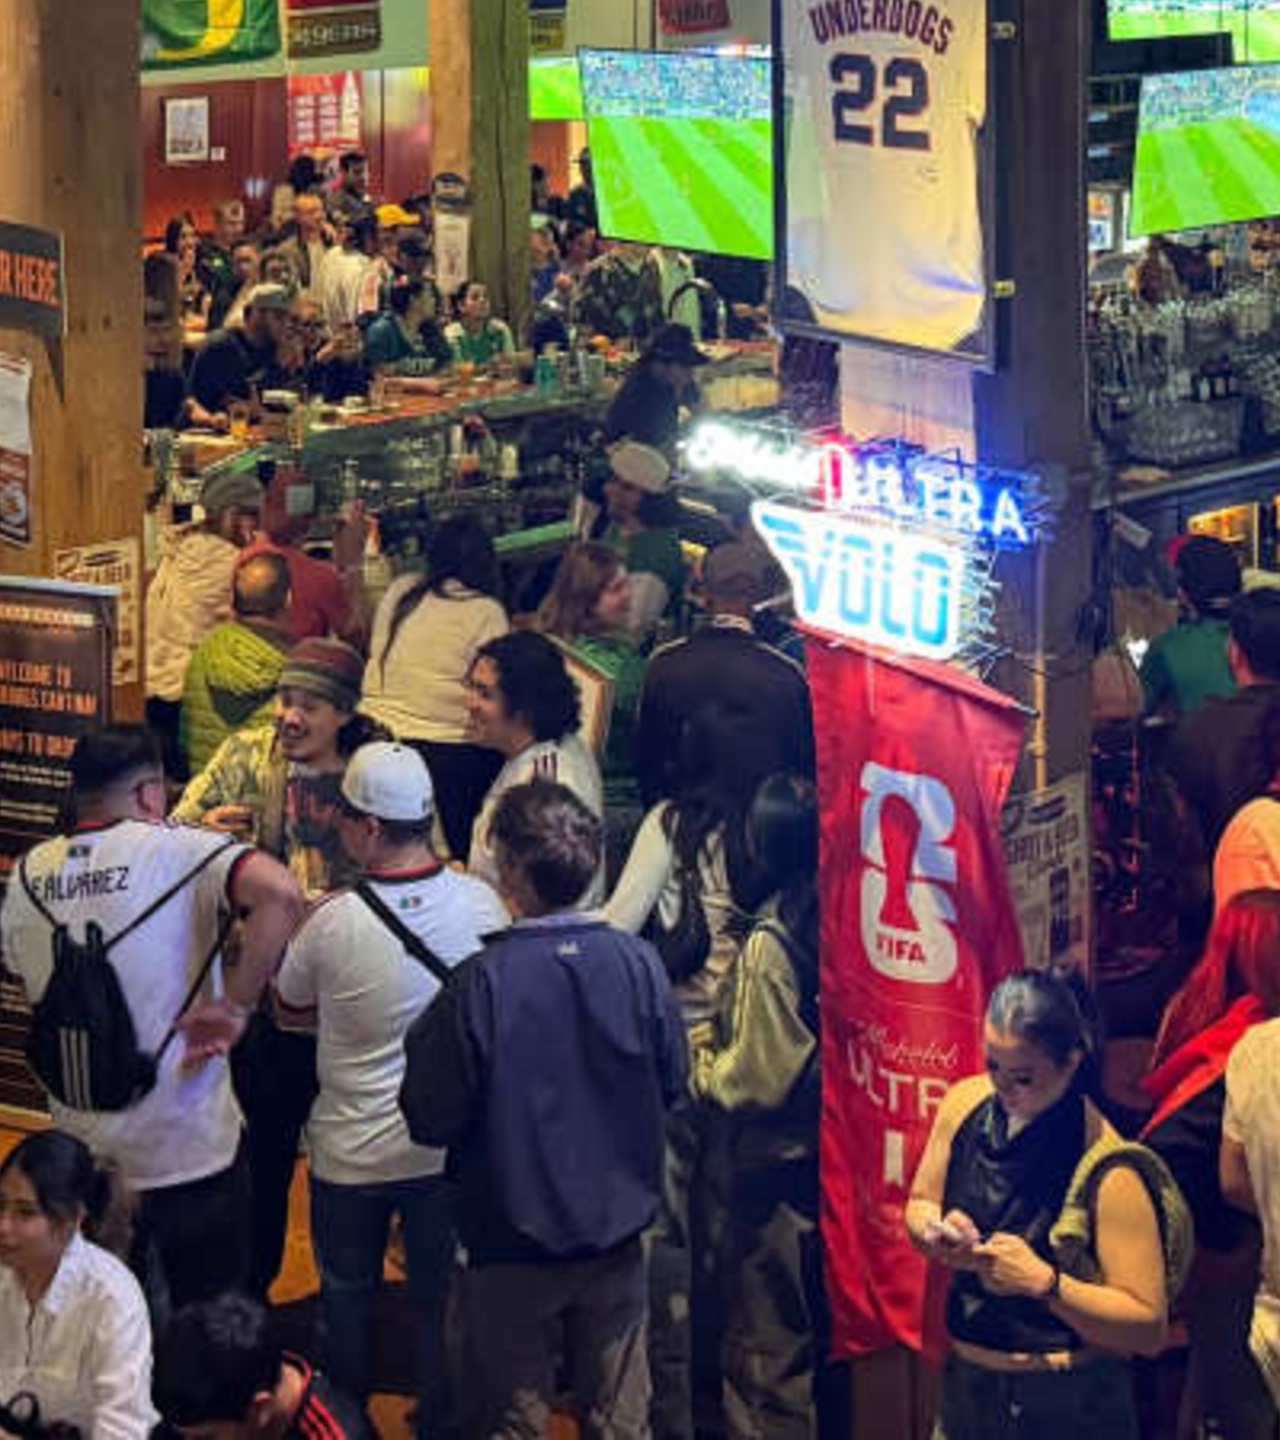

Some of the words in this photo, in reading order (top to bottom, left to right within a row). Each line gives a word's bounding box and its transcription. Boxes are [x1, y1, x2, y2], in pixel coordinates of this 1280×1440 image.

[829, 52, 932, 152] 22
[13, 250, 62, 308] HERE
[876, 932, 926, 963] FIFA
[847, 1037, 950, 1120] ULTR
